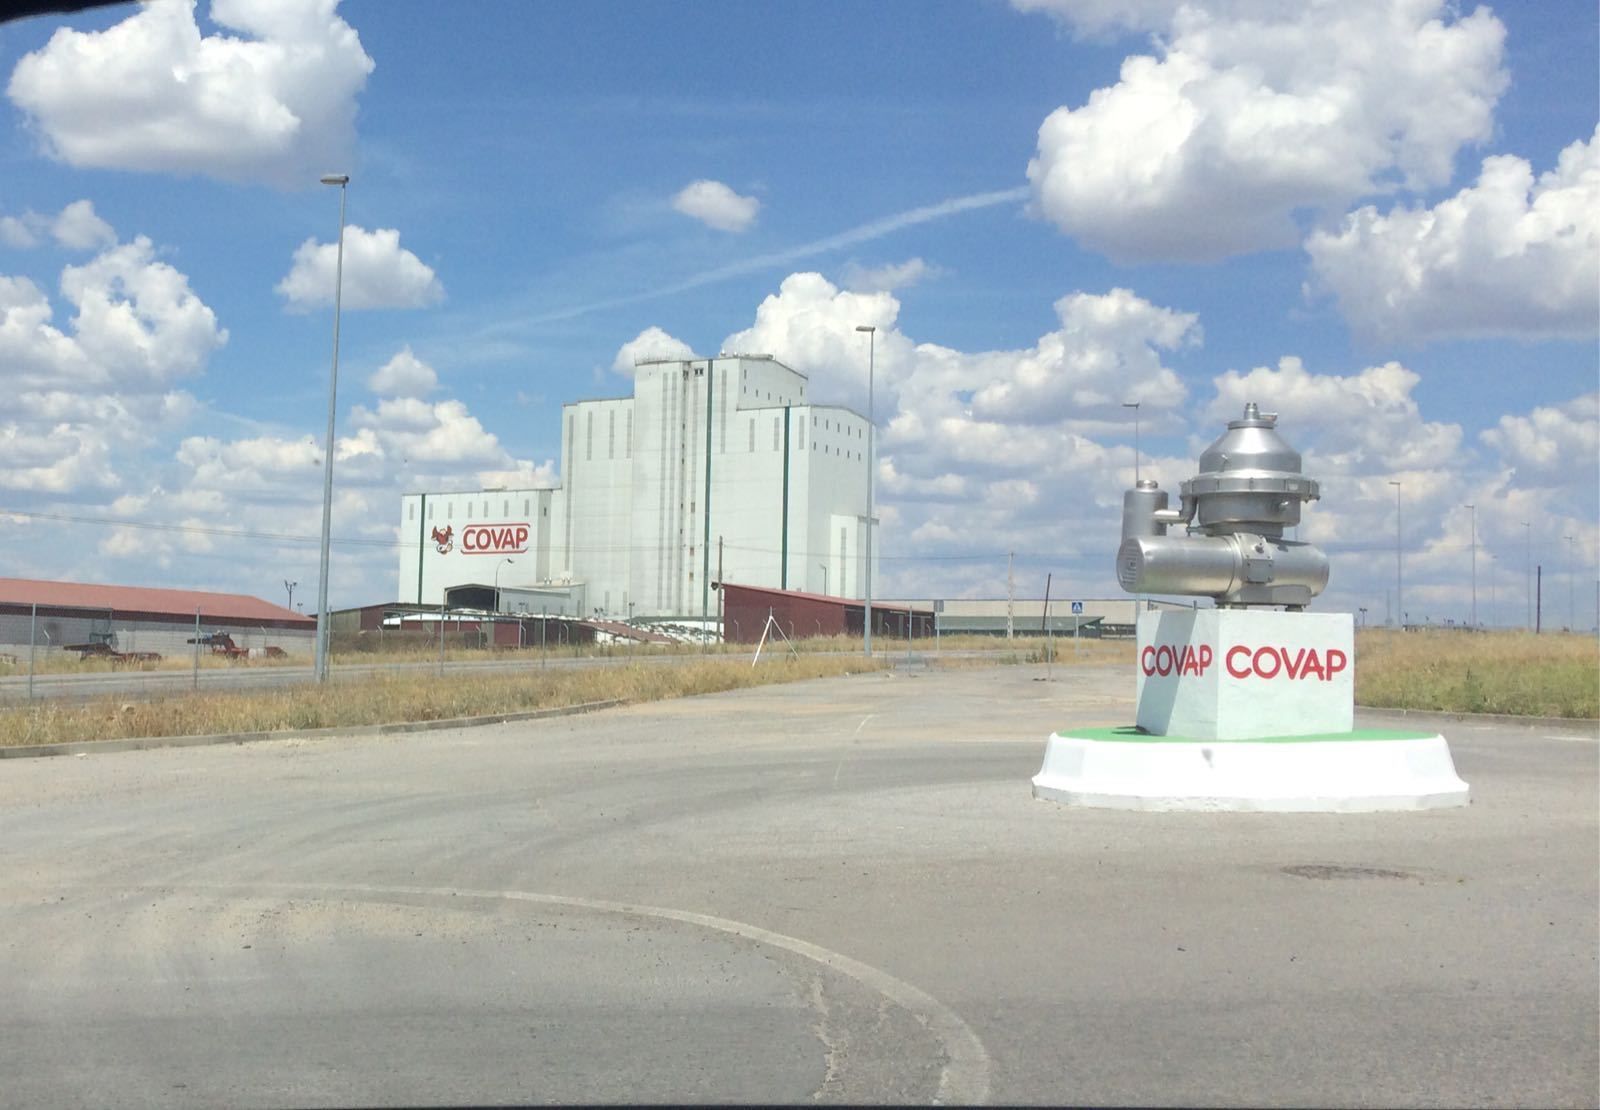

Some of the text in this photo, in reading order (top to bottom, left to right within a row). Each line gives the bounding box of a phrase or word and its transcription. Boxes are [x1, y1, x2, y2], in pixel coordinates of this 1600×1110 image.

[463, 527, 529, 550] COVAP
[1141, 644, 1213, 677] COVAP
[1225, 645, 1347, 681] COVAP
